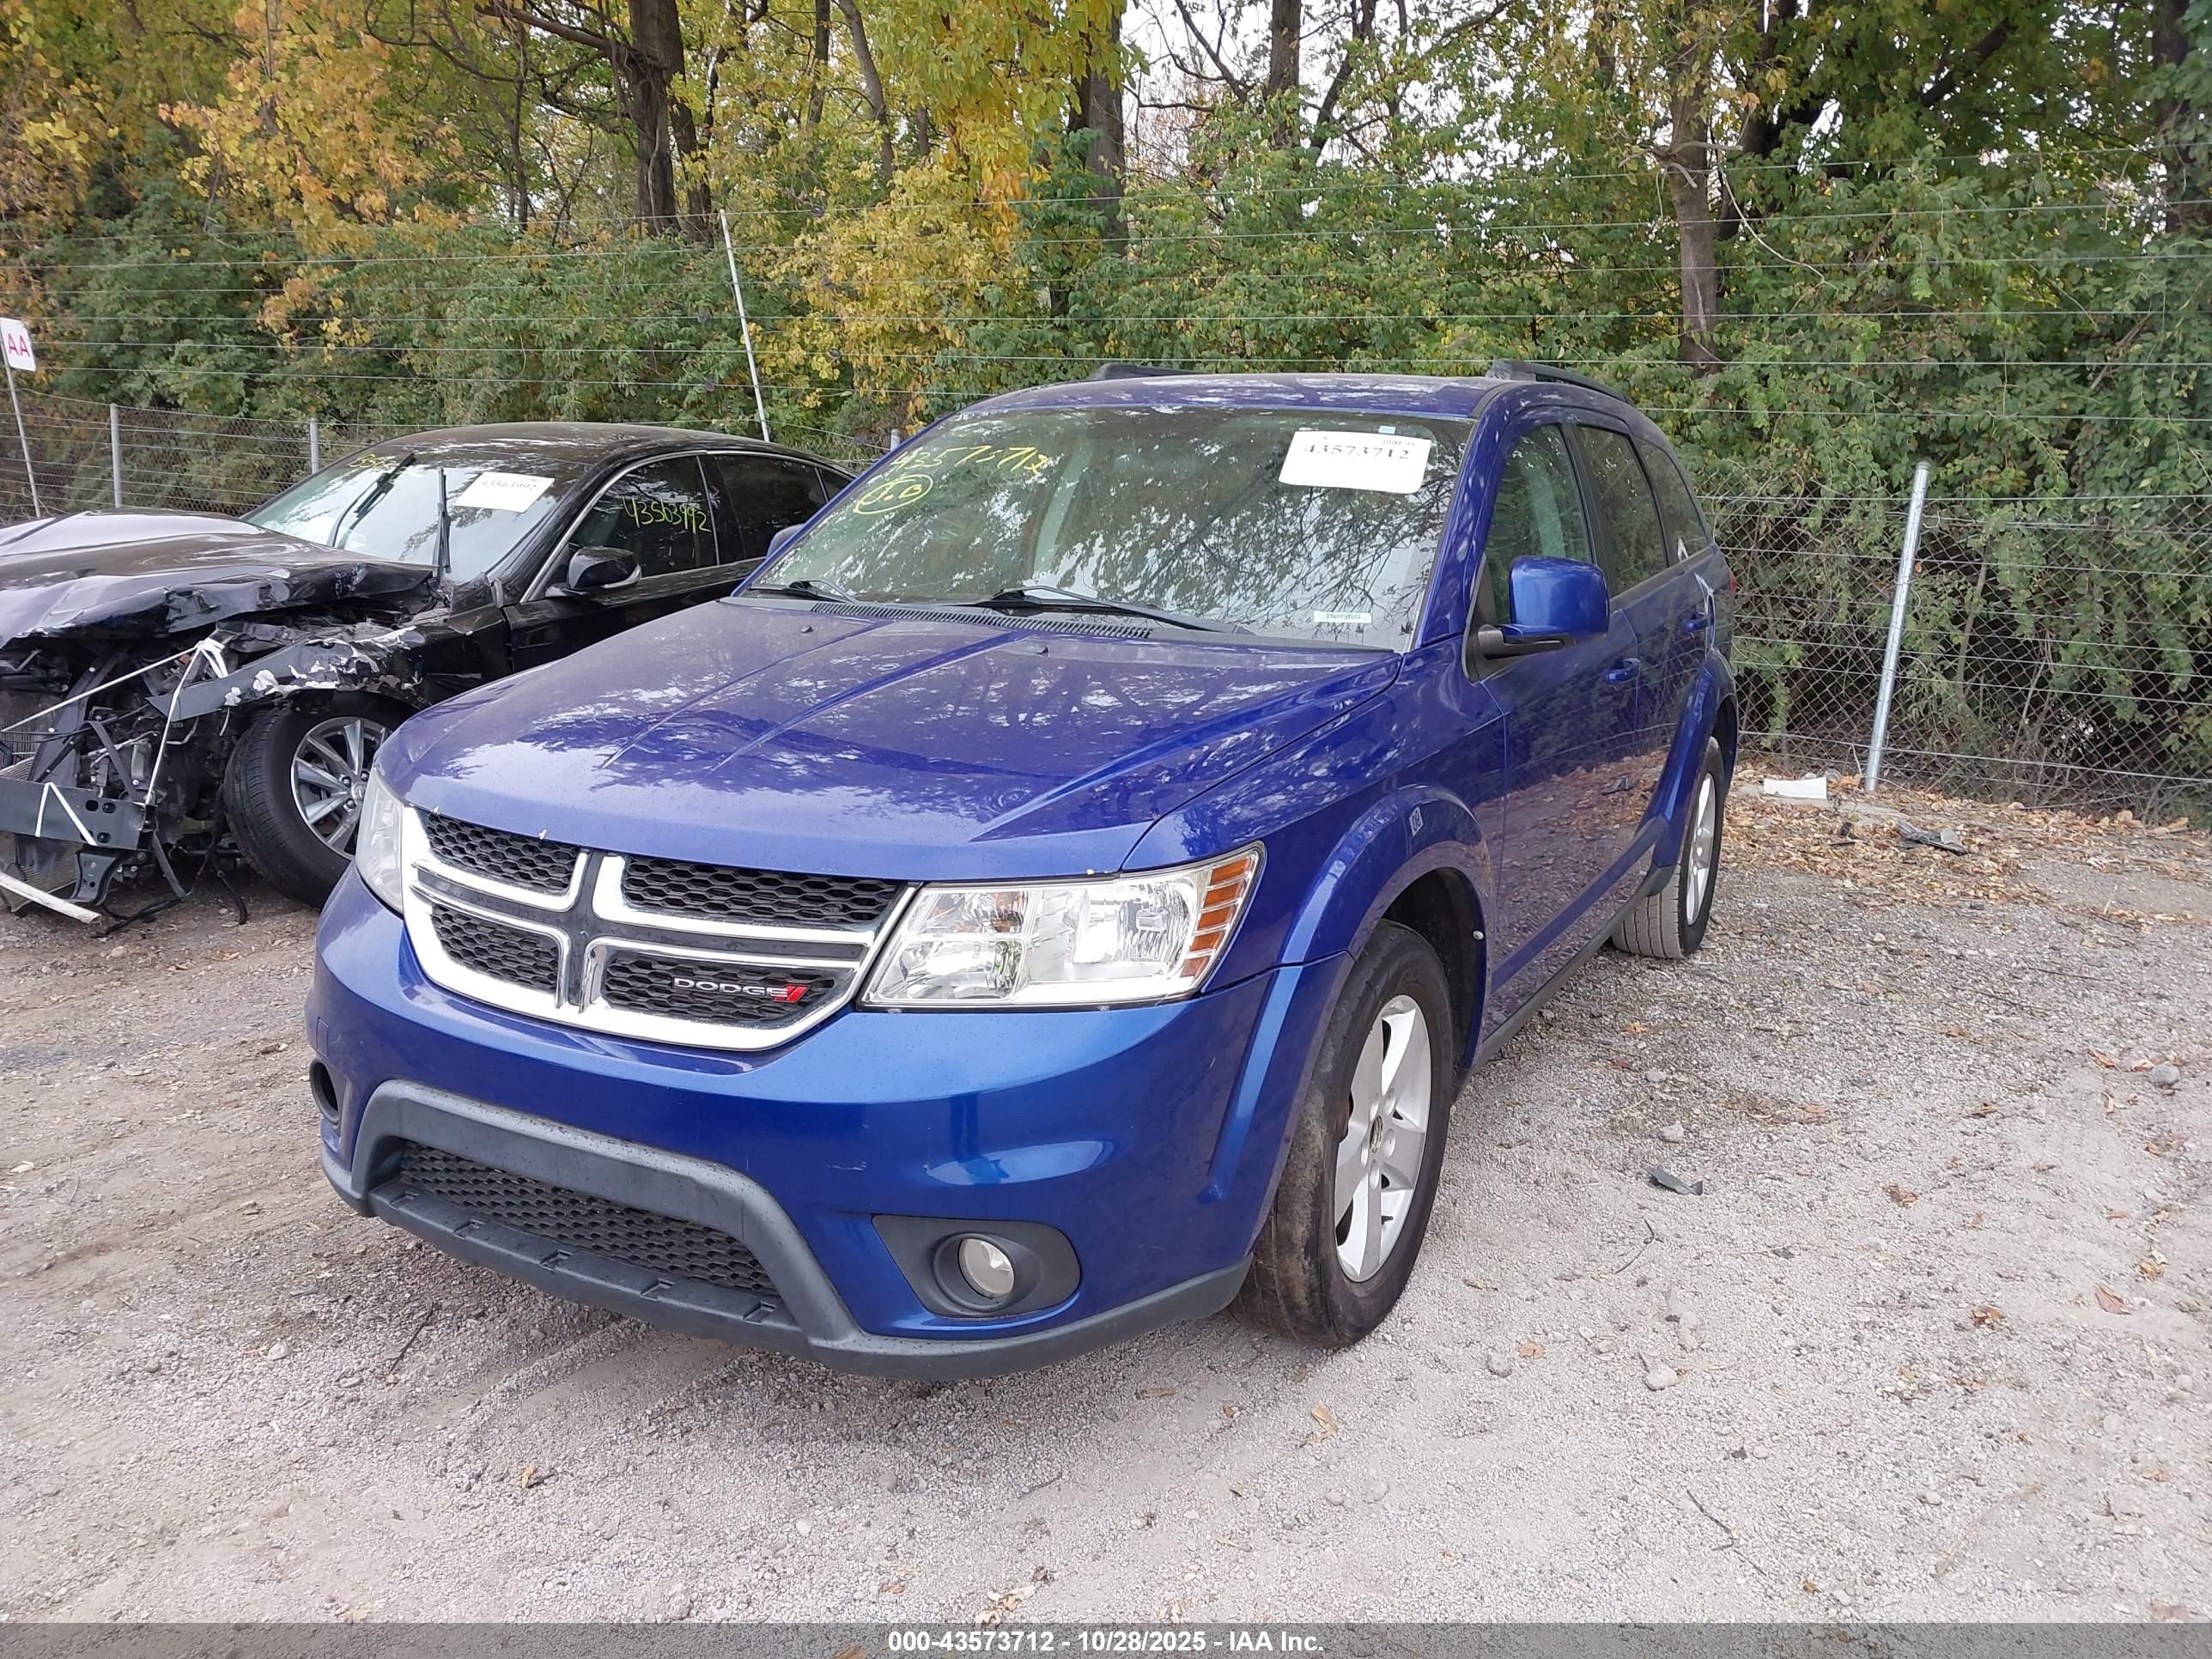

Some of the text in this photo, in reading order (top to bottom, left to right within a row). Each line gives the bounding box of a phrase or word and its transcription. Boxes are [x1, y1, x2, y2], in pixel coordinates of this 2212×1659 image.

[8, 332, 31, 357] AA
[622, 495, 712, 534] 43563992
[673, 977, 788, 998] DODGE
